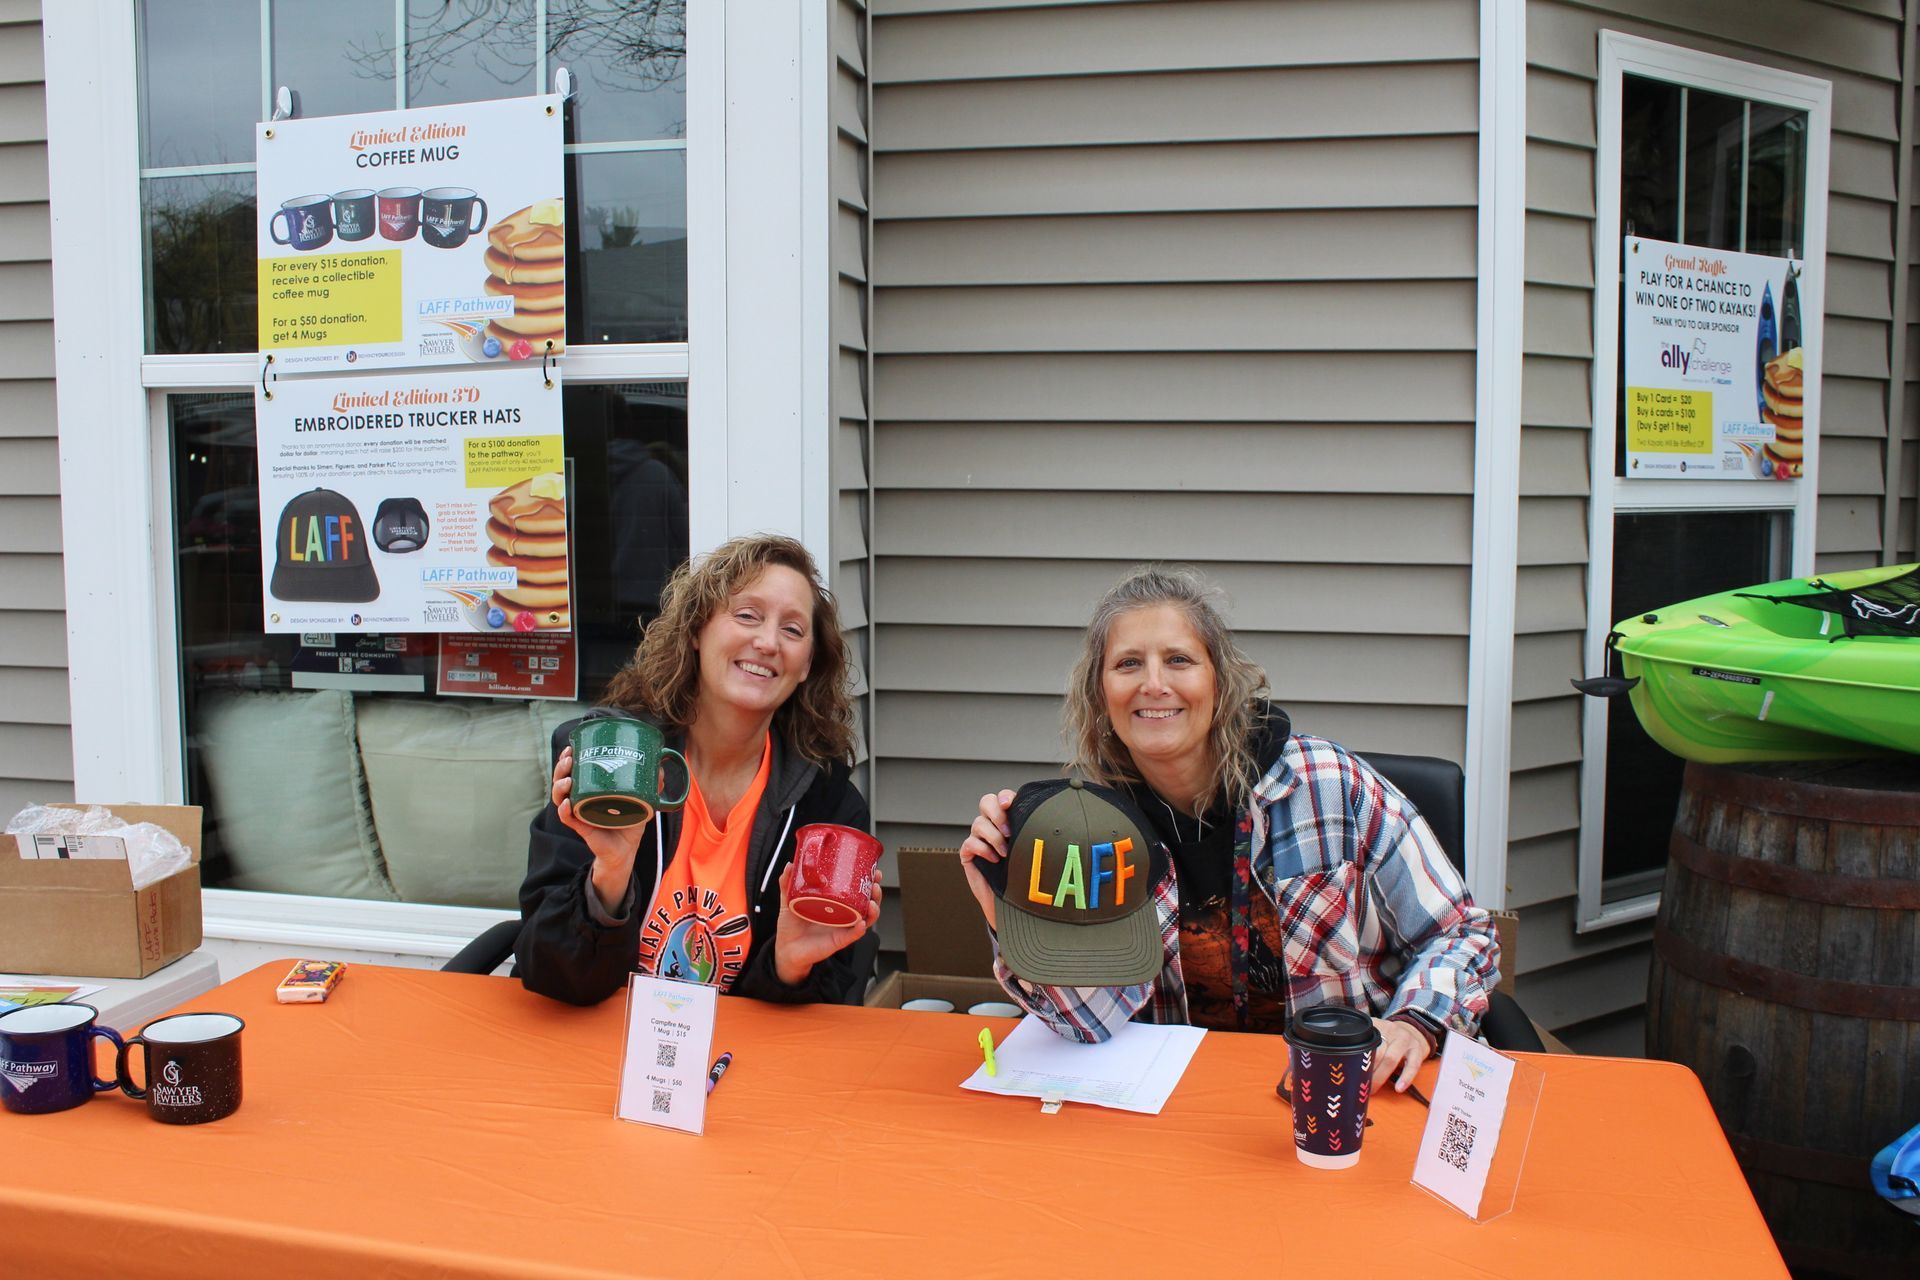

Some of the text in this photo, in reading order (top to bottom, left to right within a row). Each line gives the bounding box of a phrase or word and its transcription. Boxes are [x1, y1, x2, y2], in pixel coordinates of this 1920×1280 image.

[350, 122, 466, 151] Limited Edition
[356, 145, 460, 168] COFFEE MUG
[272, 256, 388, 272] For every $15 donation,
[1664, 253, 1728, 276] Grand Raffle
[272, 275, 310, 286] receive
[322, 270, 375, 283] collectible
[1640, 270, 1752, 298] PLAY FOR A CHANCE TO
[272, 288, 330, 300] coffee mug
[419, 298, 513, 315] LAFF Pathway
[1636, 291, 1757, 318] WIN ONE OF TWO KAYAKS!
[273, 312, 367, 328] For a $50 donation,
[1652, 316, 1740, 333] THANK YOU TO OUR SPONSOR
[273, 329, 328, 343] get 4 Mugs
[419, 343, 456, 357] JEWELERS
[1661, 344, 1732, 375] ally challenge
[332, 390, 389, 413] Limited
[392, 388, 448, 407] Edition
[1637, 392, 1648, 404] Buy
[1650, 393, 1654, 402] 1
[1656, 394, 1671, 404] Card
[295, 408, 522, 432] EMBROIDERED TRUCKER HATS
[1637, 406, 1648, 418] Buy
[1656, 408, 1673, 417] cards
[1681, 408, 1696, 419] $100
[1637, 420, 1652, 432] (buy
[1659, 421, 1669, 433] get
[1676, 421, 1691, 434] free)
[1722, 423, 1774, 437] LAFF Pathway
[469, 441, 479, 449] For
[488, 440, 505, 449] $100
[507, 438, 540, 447] donation
[469, 451, 476, 459] to
[290, 515, 354, 562] LAFF
[422, 568, 515, 583] LAFF Pathway
[424, 610, 460, 624] JEWELERS
[427, 605, 458, 614] SAWYER
[601, 746, 644, 760] Pathway
[1028, 837, 1135, 910] LAFF
[639, 906, 672, 961] LAFF
[651, 1018, 690, 1031] Campfire Mug
[658, 1027, 670, 1036] Mug
[0, 1060, 56, 1074] FF Pathway
[651, 1075, 666, 1084] Mugs
[156, 1085, 200, 1097] SAWYER
[1459, 1079, 1485, 1098] Trucker Hats
[153, 1088, 202, 1105] JEWELERS
[1464, 1091, 1475, 1102] $100
